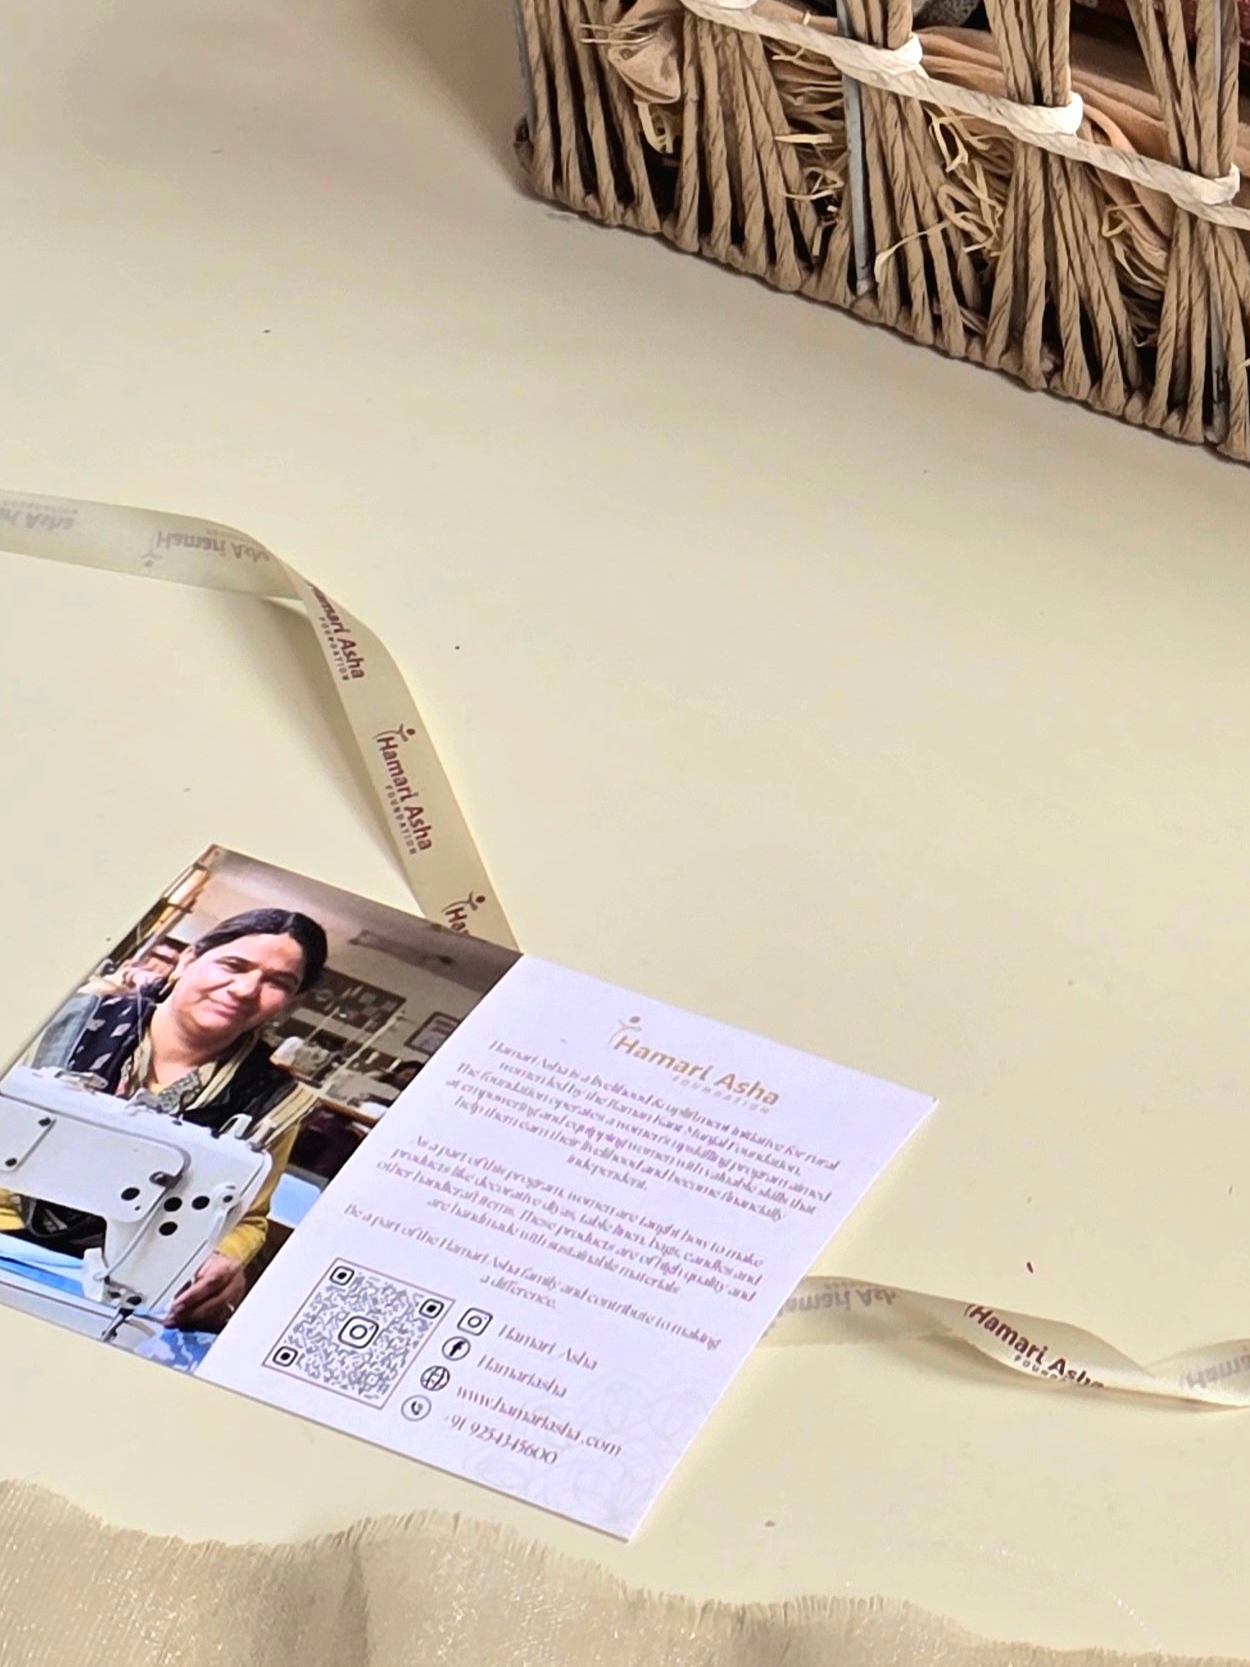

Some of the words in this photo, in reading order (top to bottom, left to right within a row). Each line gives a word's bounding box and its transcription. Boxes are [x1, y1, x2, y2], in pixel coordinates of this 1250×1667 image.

[337, 637, 365, 679] Asha
[377, 736, 419, 802] Hamari
[404, 805, 433, 851] Asha
[385, 784, 417, 854] FOUNDATION
[613, 1035, 714, 1081] Hamari
[713, 1072, 780, 1106] Asha
[968, 1304, 1048, 1365] Hamari
